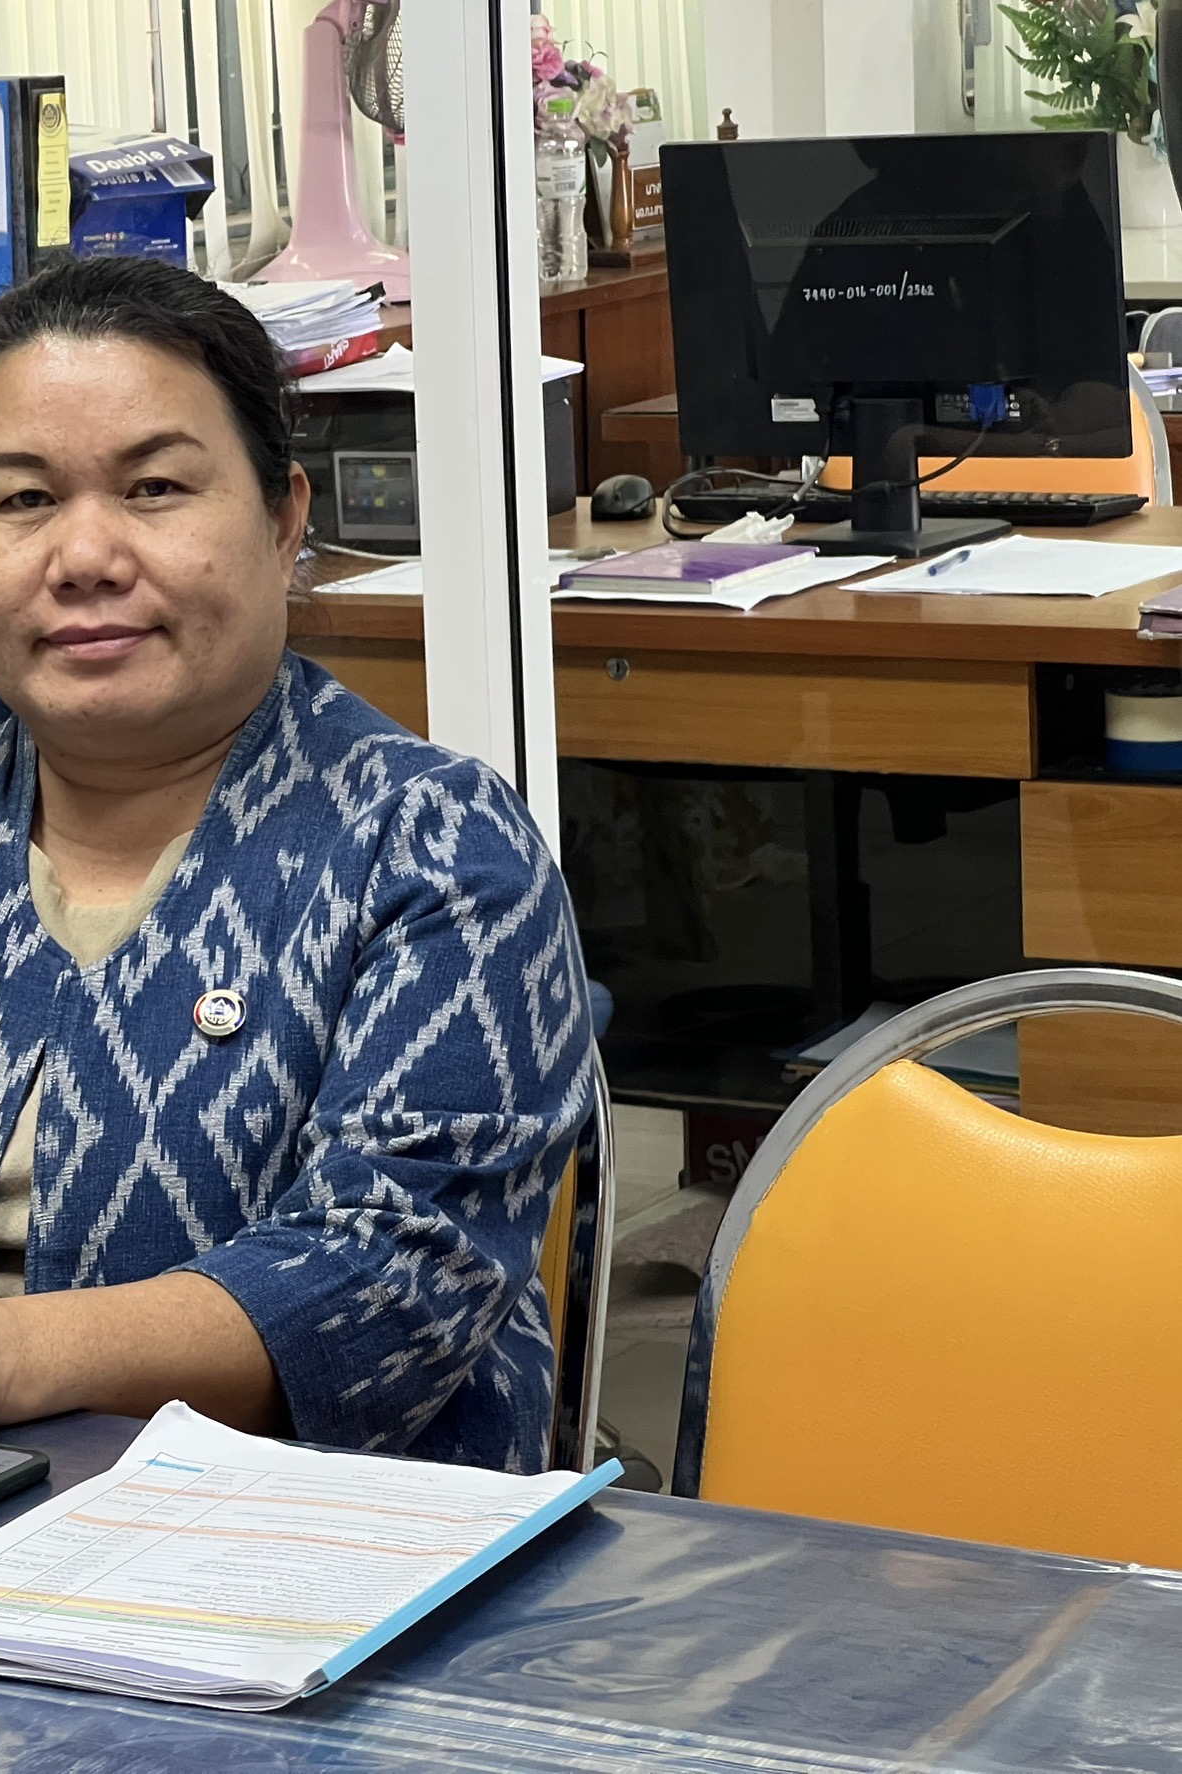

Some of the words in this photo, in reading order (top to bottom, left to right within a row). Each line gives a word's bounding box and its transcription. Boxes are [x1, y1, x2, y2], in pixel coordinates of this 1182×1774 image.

[86, 150, 166, 174] Double
[166, 143, 189, 157] A
[143, 170, 157, 183] A
